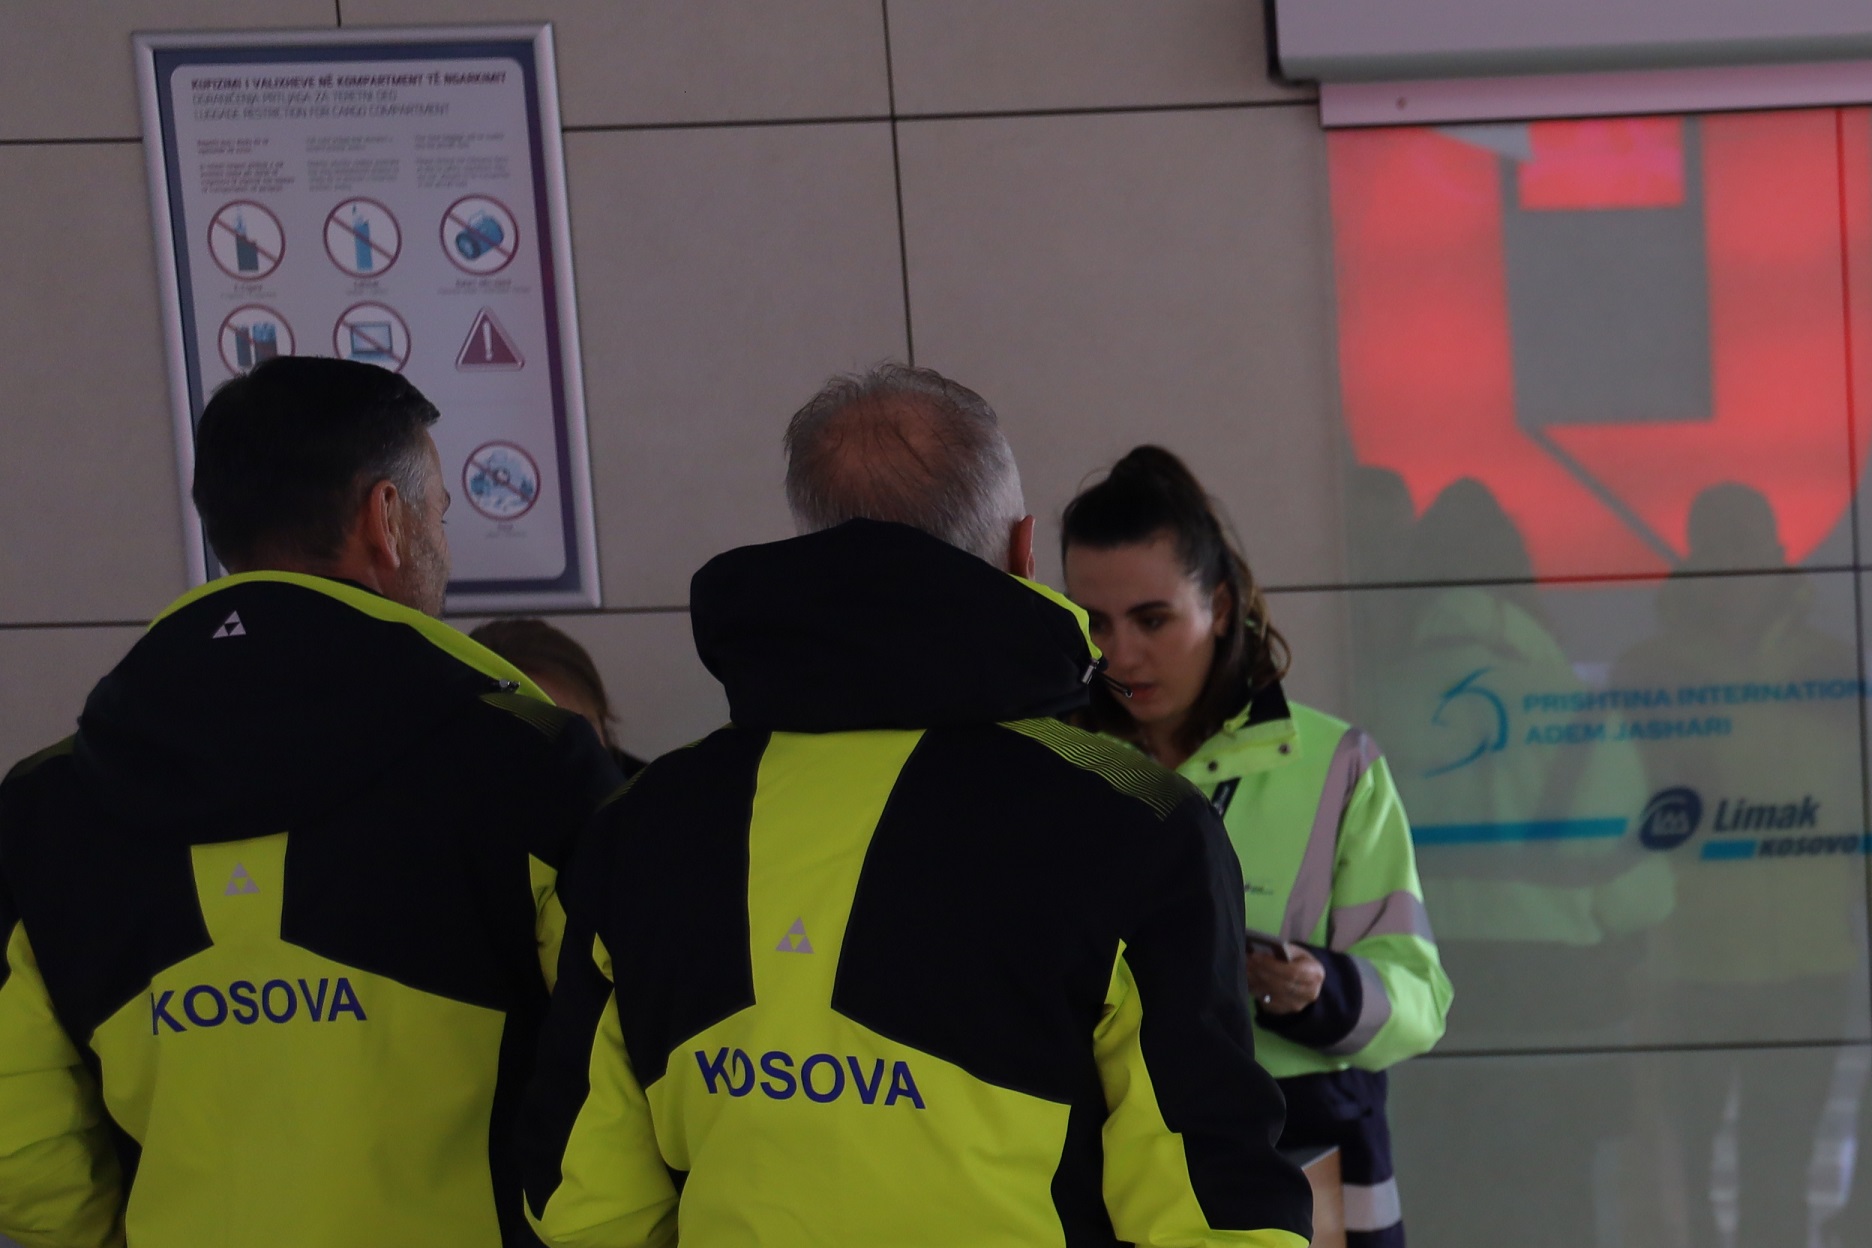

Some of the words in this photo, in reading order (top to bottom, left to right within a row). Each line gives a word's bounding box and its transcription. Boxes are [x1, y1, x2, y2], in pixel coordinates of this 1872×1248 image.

[1523, 687, 1671, 712] PRISHTINA
[1525, 722, 1606, 745] ADEM
[1614, 715, 1733, 742] JASHARI
[1712, 796, 1820, 832] Limak
[151, 977, 368, 1036] KOSOVA
[694, 1046, 926, 1110] KOSOVA
